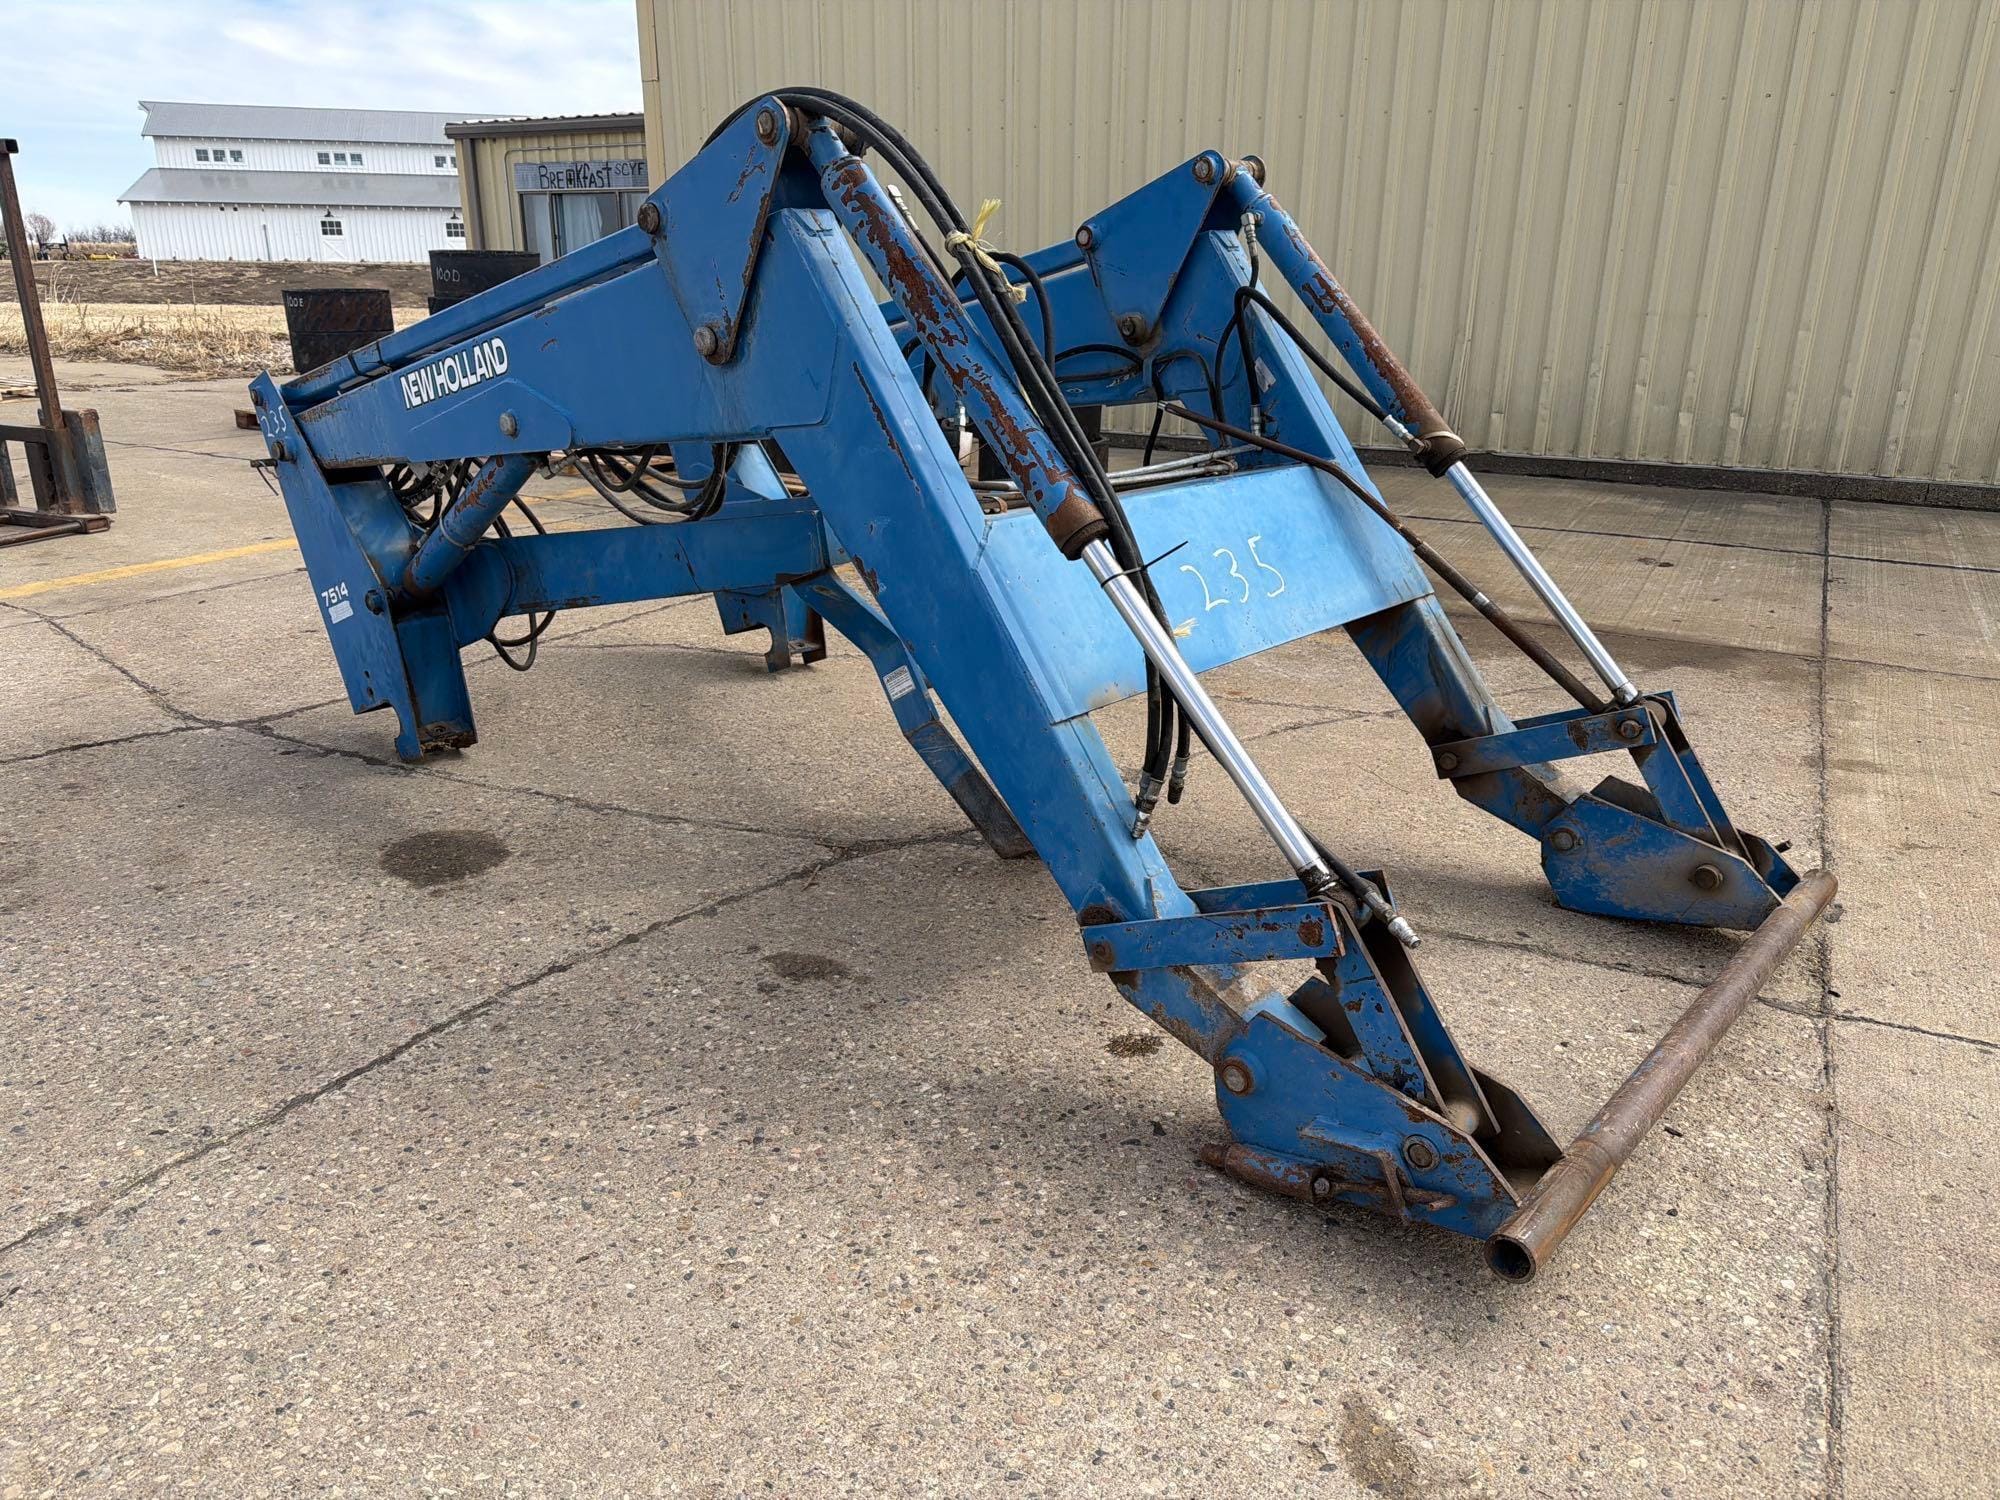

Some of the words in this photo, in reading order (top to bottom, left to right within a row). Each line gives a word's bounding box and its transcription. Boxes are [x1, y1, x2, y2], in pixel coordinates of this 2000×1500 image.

[400, 366, 435, 410] NEW
[432, 337, 508, 397] HOLLAND
[261, 405, 287, 437] 235
[321, 581, 349, 608] 7514
[1179, 535, 1285, 612] 235
